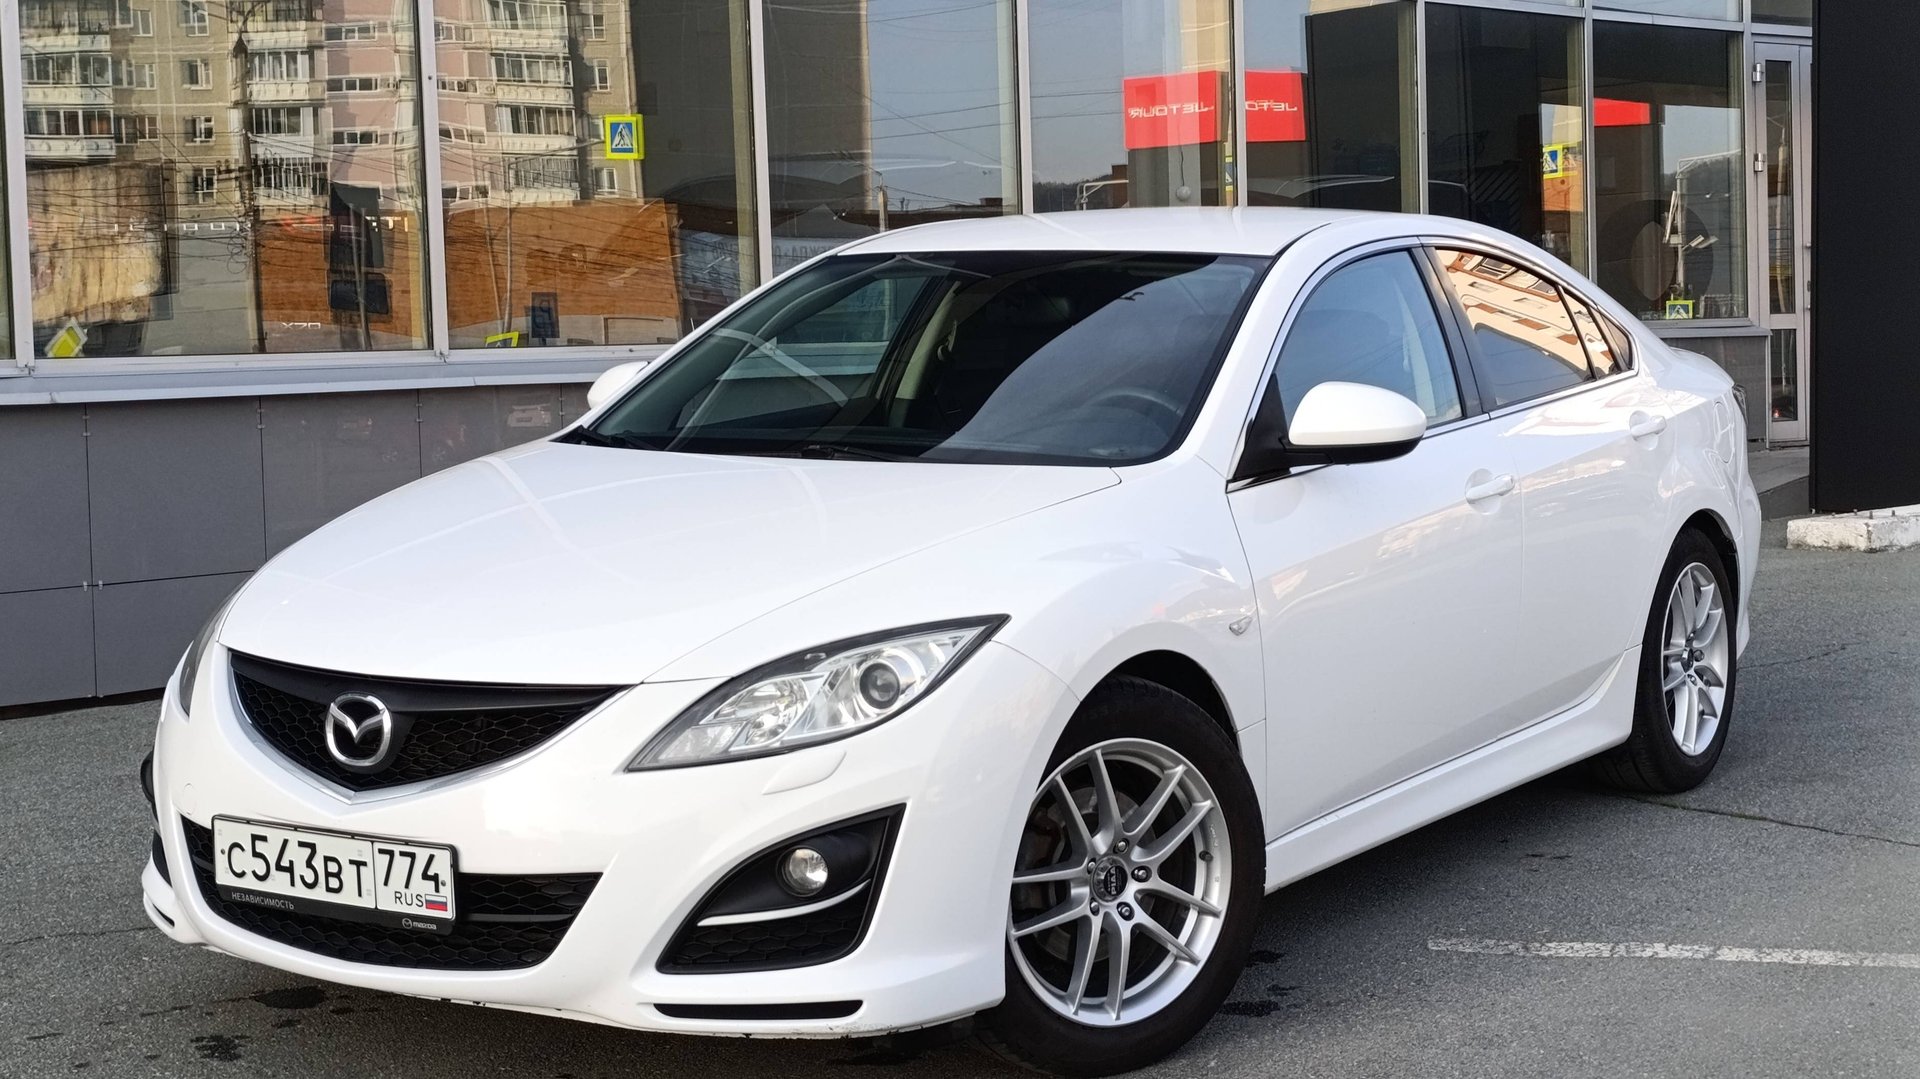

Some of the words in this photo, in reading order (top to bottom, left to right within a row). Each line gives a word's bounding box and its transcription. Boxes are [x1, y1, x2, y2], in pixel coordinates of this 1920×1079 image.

[227, 833, 368, 897] С543ВТ
[378, 848, 440, 893] 774
[231, 891, 295, 910] НЕЗАВИСИМОСТЬ
[395, 891, 424, 908] RUS
